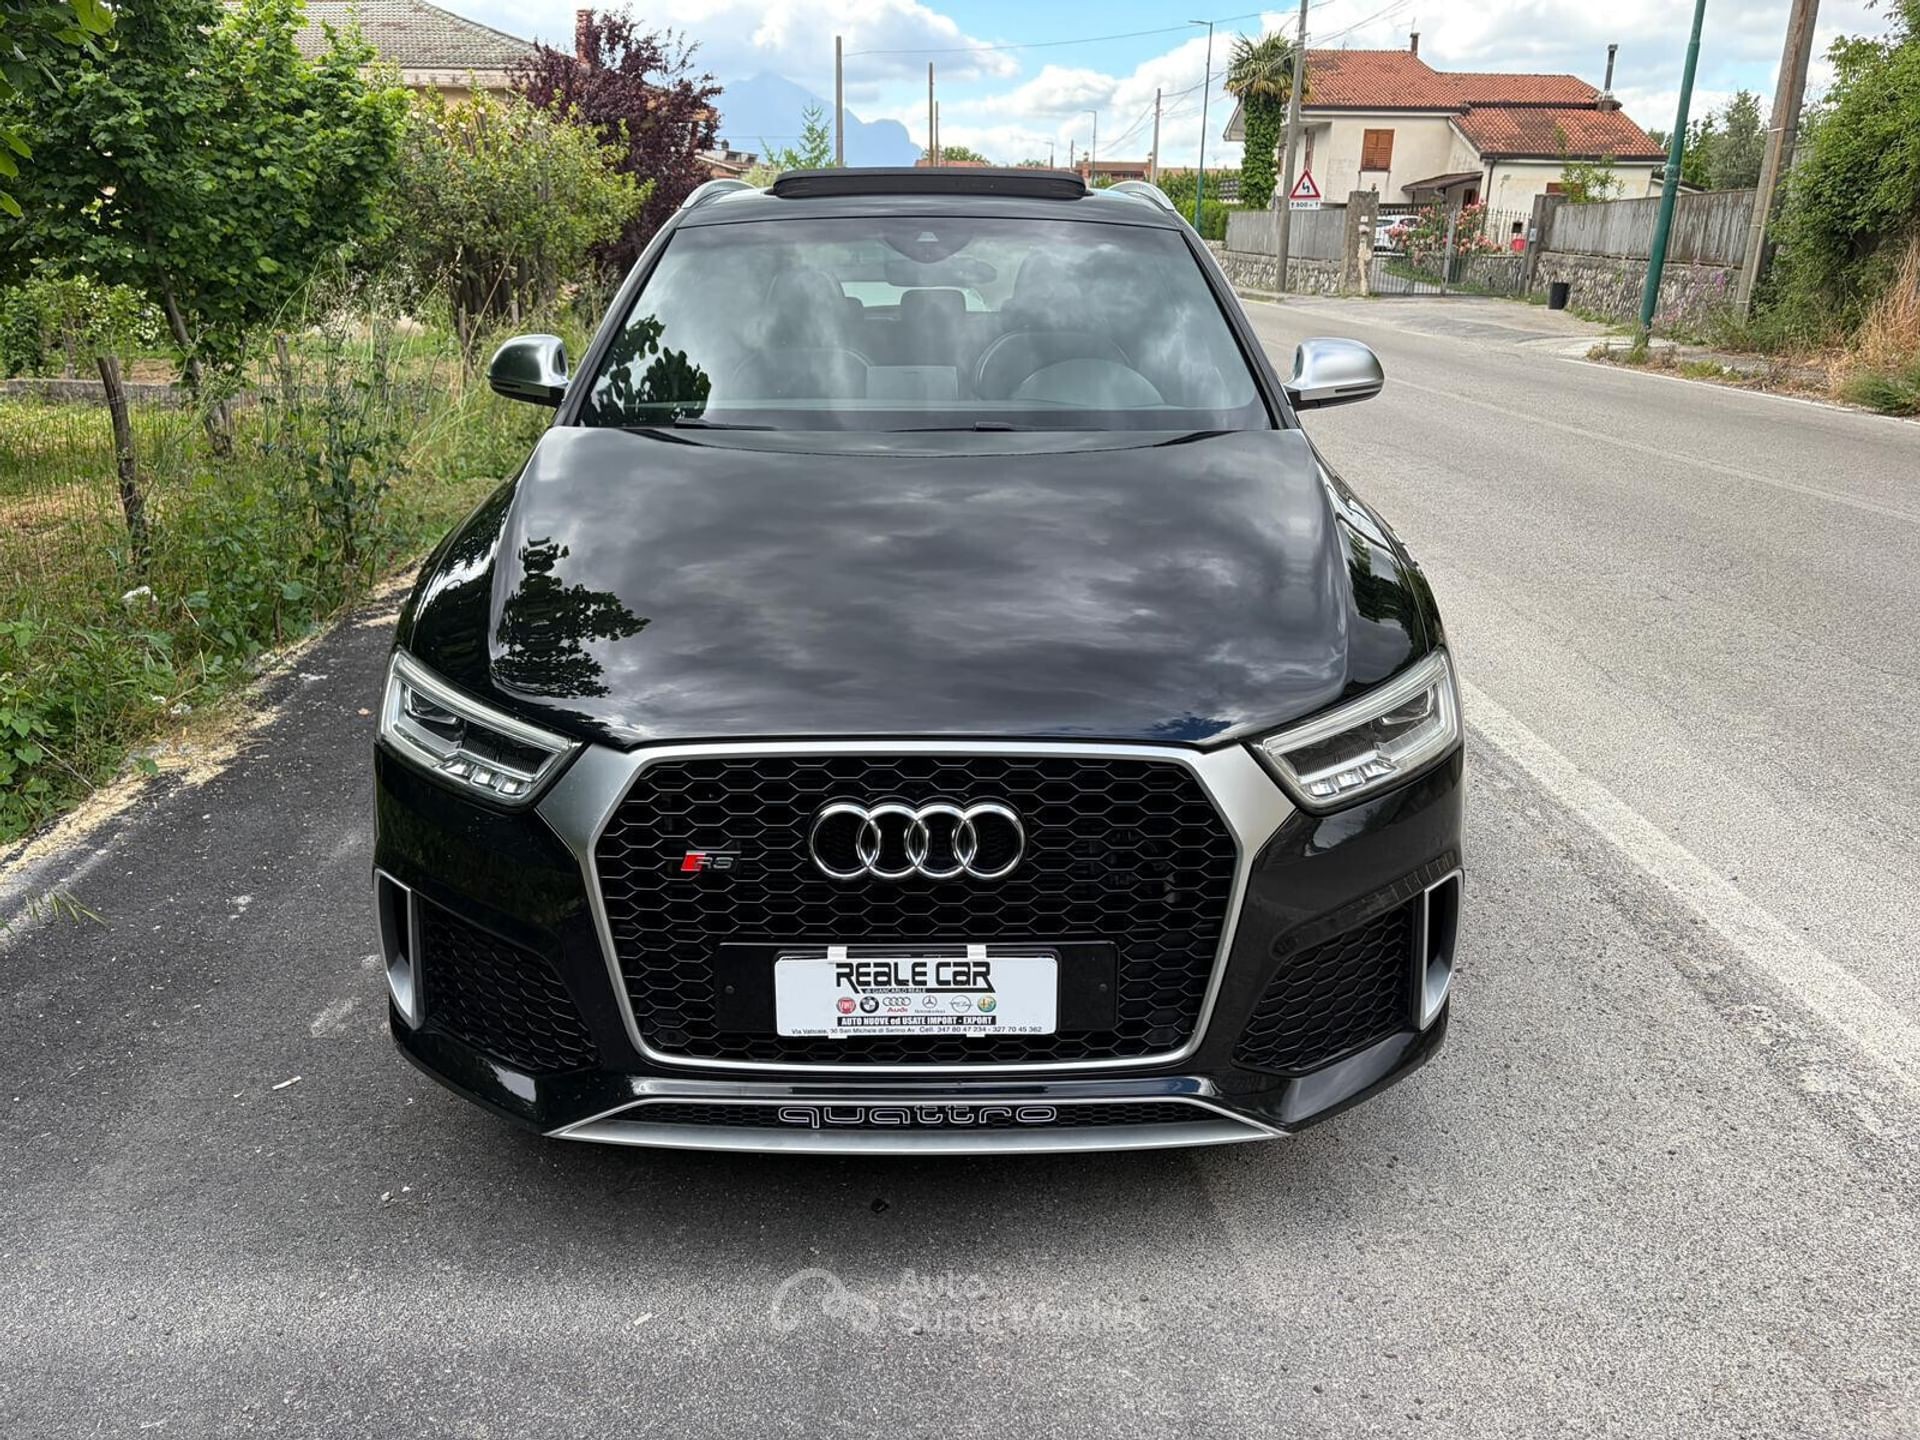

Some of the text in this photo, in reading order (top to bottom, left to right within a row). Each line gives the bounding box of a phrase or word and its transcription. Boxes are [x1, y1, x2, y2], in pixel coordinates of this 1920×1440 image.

[695, 856, 734, 869] RS
[841, 1017, 862, 1026] AUTO
[863, 1017, 889, 1025] NUOVE
[890, 1017, 900, 1025] ed
[902, 1017, 926, 1025] USATE
[927, 1016, 957, 1025] IMPORT
[963, 1016, 992, 1024] EXPORT
[778, 1104, 1057, 1129] quattro
